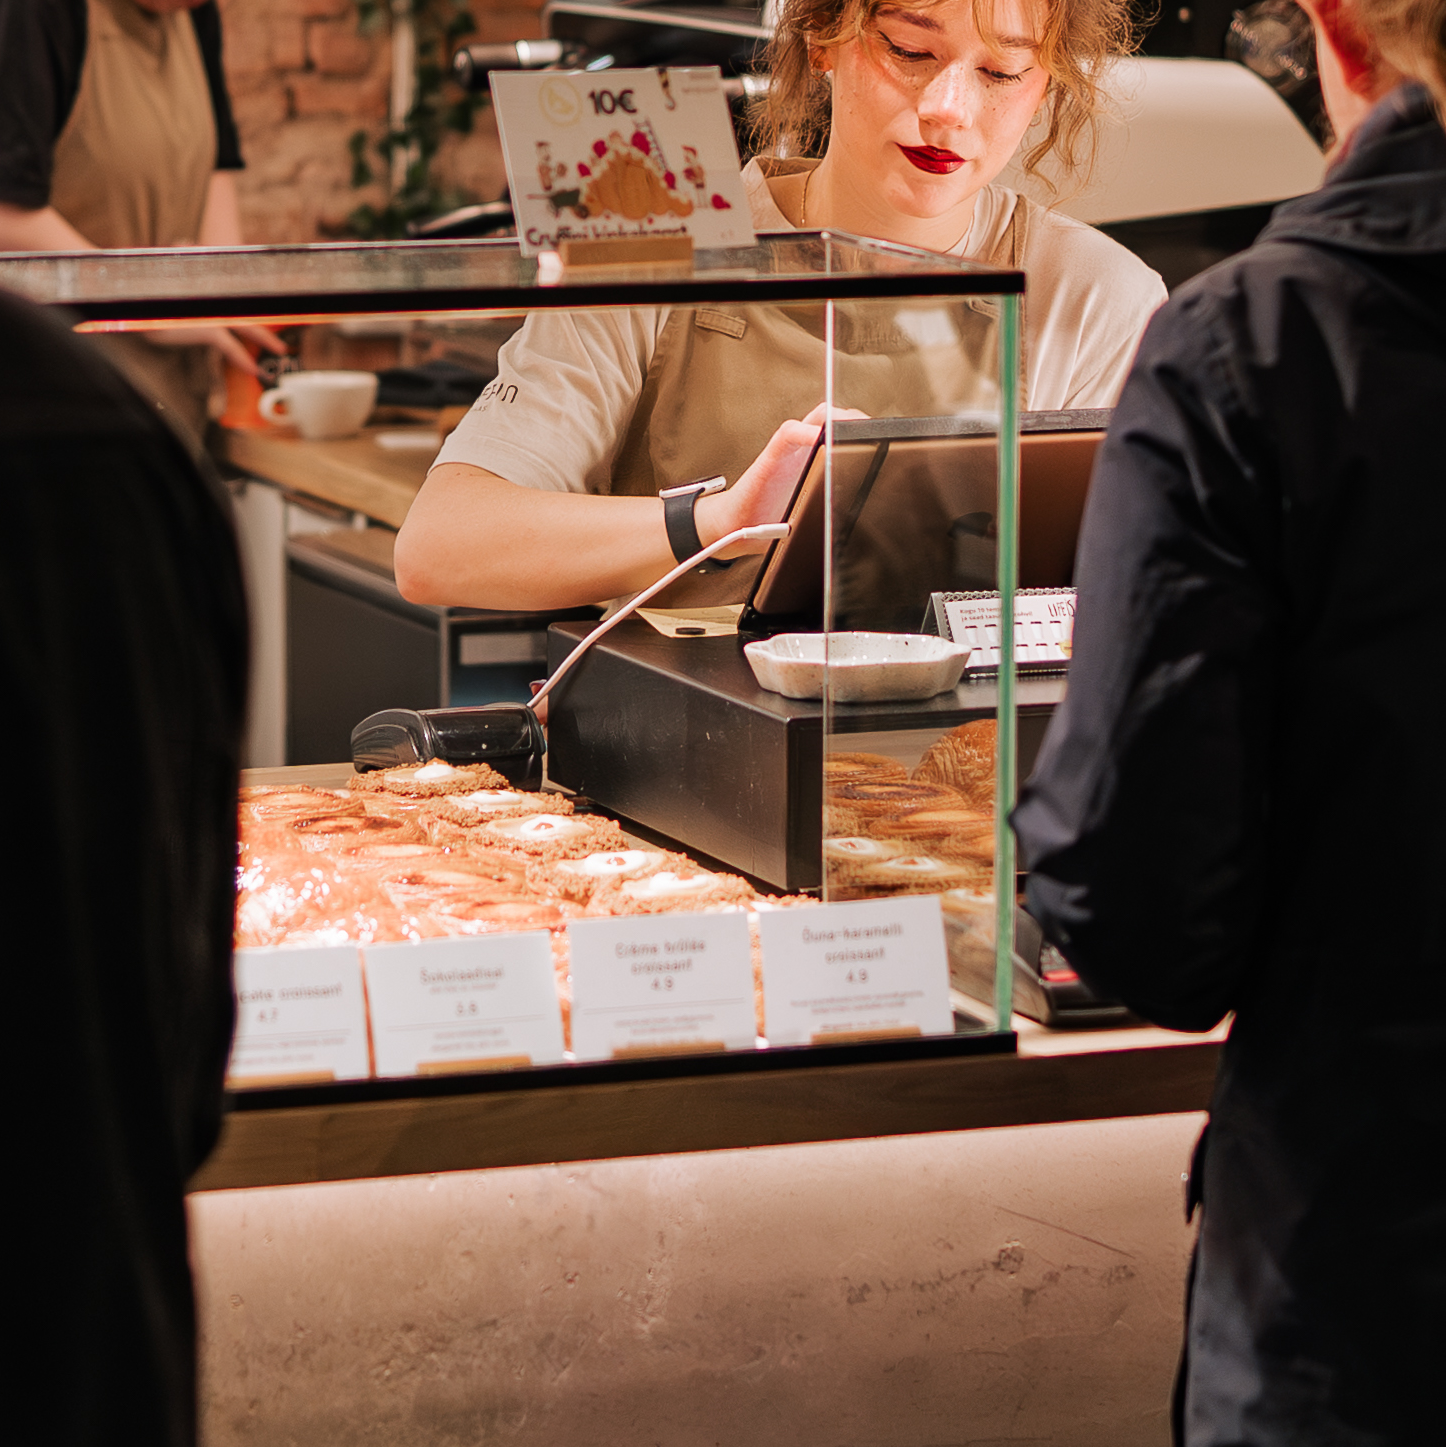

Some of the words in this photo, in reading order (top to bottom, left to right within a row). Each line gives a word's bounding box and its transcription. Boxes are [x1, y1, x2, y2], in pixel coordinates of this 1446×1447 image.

[587, 89, 637, 115] 10€
[824, 946, 886, 964] croissant
[630, 957, 693, 975] croissant
[279, 982, 342, 1000] croissant
